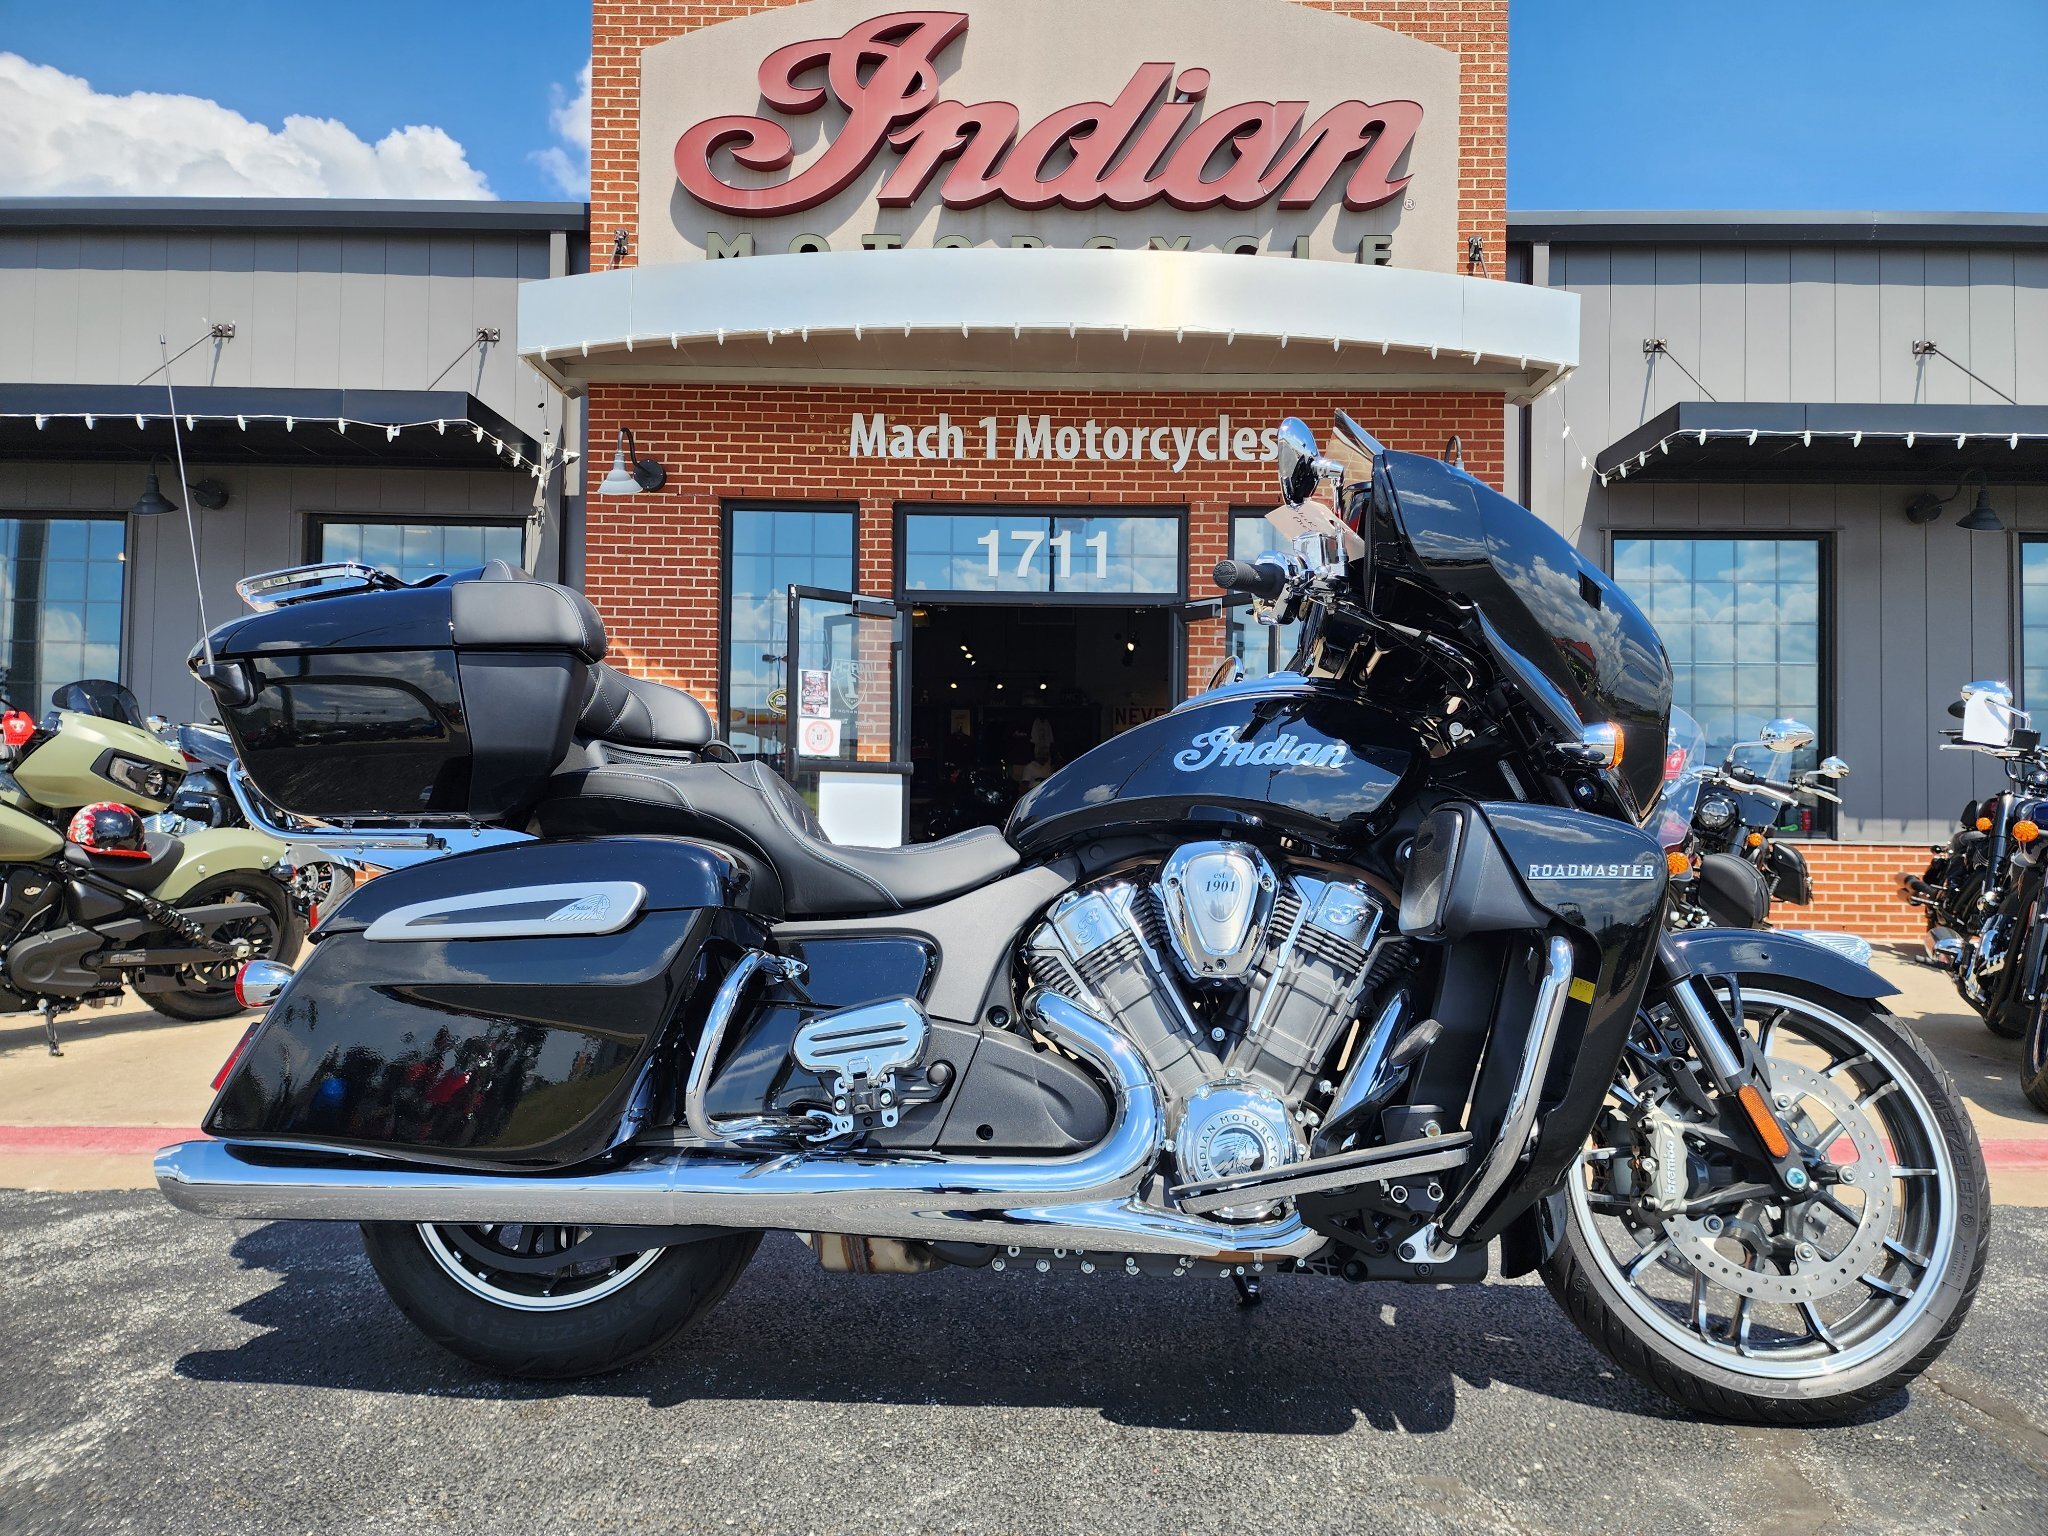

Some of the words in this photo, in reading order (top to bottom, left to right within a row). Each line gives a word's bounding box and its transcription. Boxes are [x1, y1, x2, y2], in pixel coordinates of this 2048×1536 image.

[673, 11, 1424, 217] Indian
[849, 412, 964, 459] Mach
[978, 416, 997, 459] 1
[1015, 414, 1279, 473] Motorcycles
[977, 529, 1108, 579] 1711
[1115, 707, 1165, 725] NEV
[1173, 725, 1349, 772] Indian
[1205, 879, 1236, 892] 1901
[1528, 864, 1654, 877] ROADMASTER
[1200, 1124, 1216, 1178] INDIAN
[1219, 1113, 1278, 1170] MOTORCYC
[1664, 1138, 1677, 1196] brembo
[1928, 1090, 1974, 1210] METZELER
